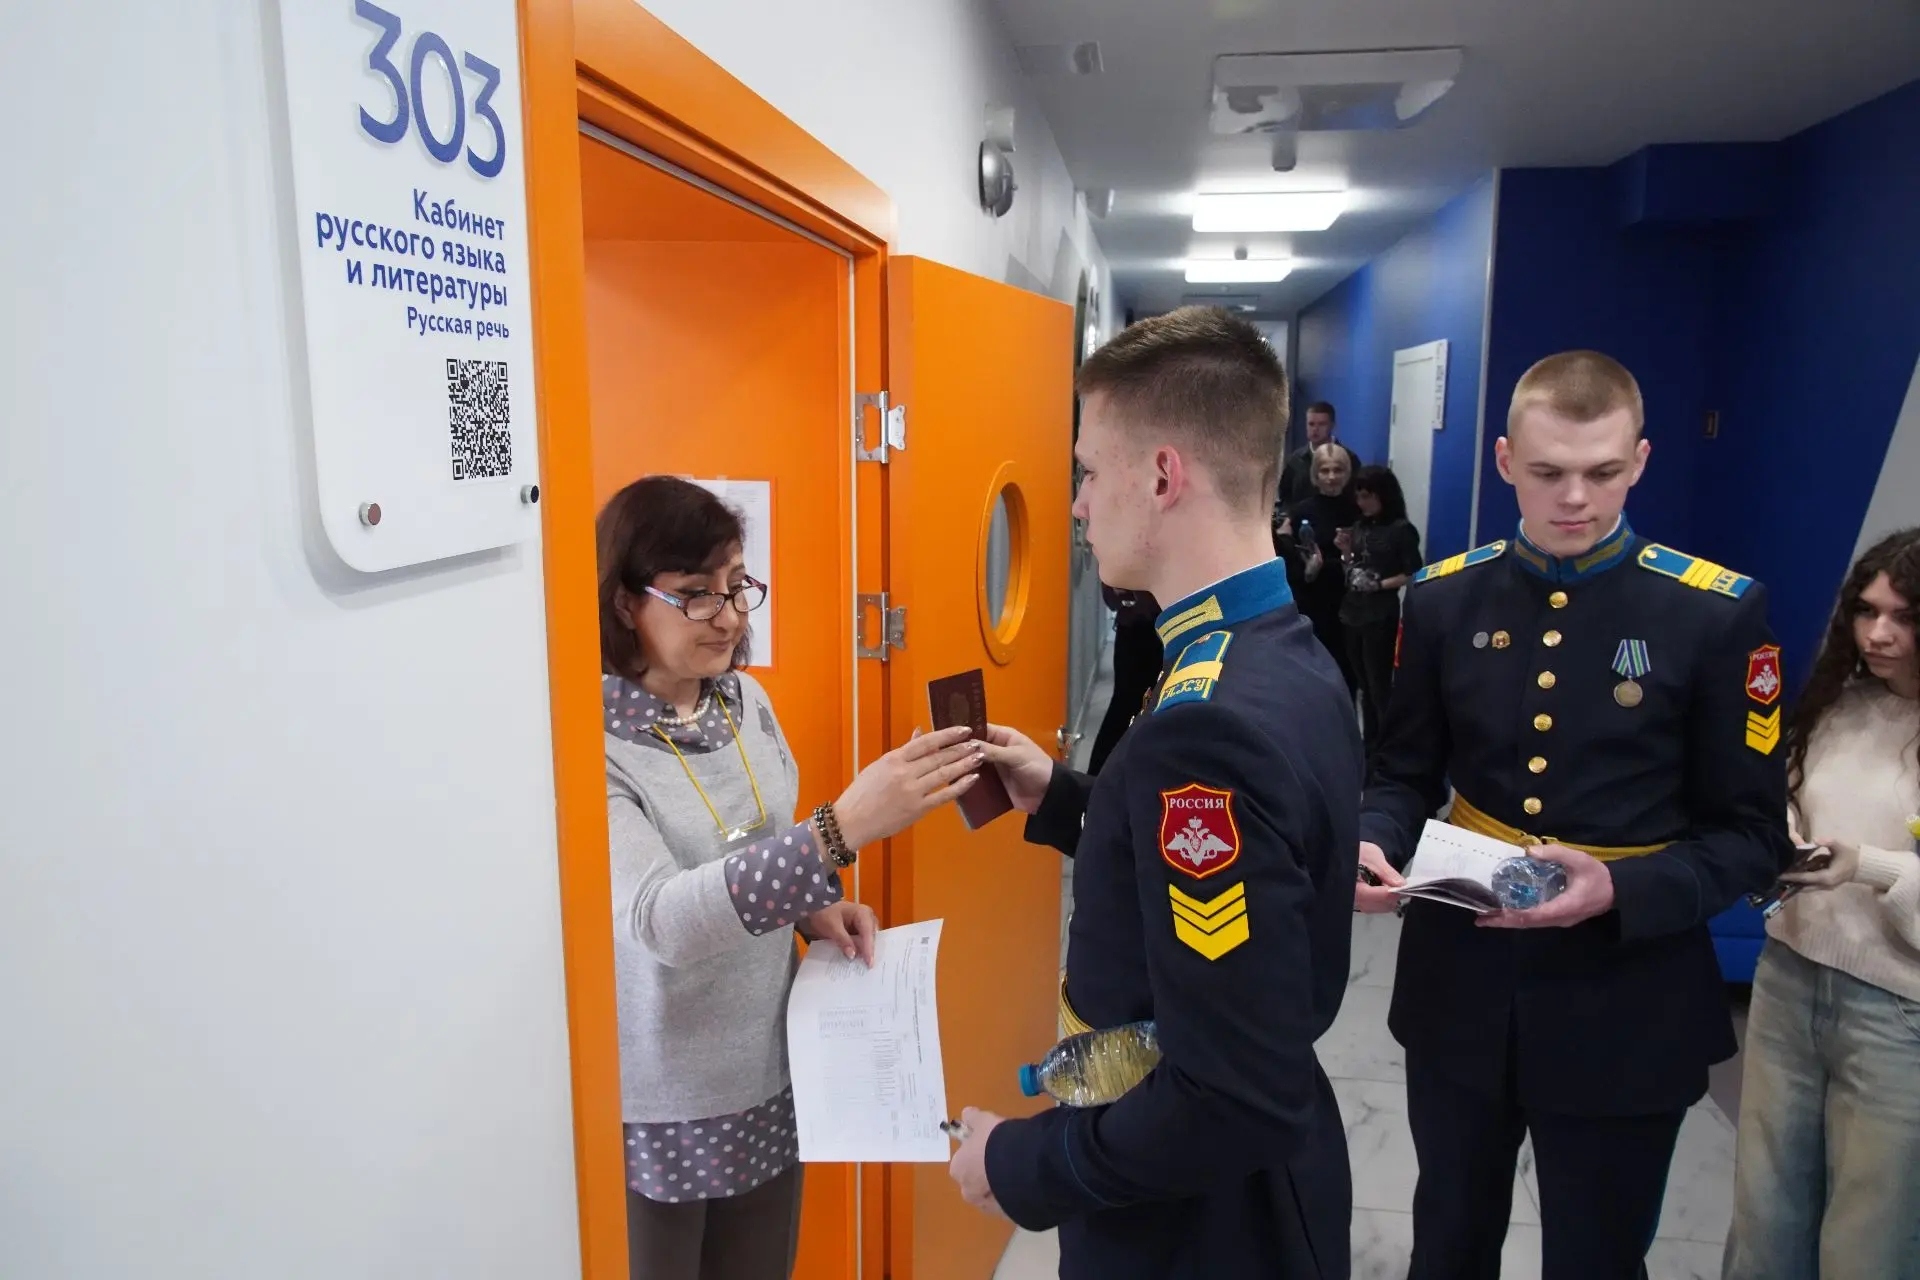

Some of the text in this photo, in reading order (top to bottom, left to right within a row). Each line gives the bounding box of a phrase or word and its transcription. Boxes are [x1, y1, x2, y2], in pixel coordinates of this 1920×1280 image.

[355, 0, 506, 179] 303
[412, 189, 505, 241] Кабинет
[315, 211, 506, 274] русского языка
[346, 259, 508, 309] и литературы
[405, 306, 509, 339] Русская речь
[1169, 797, 1225, 809] РОССИЯ
